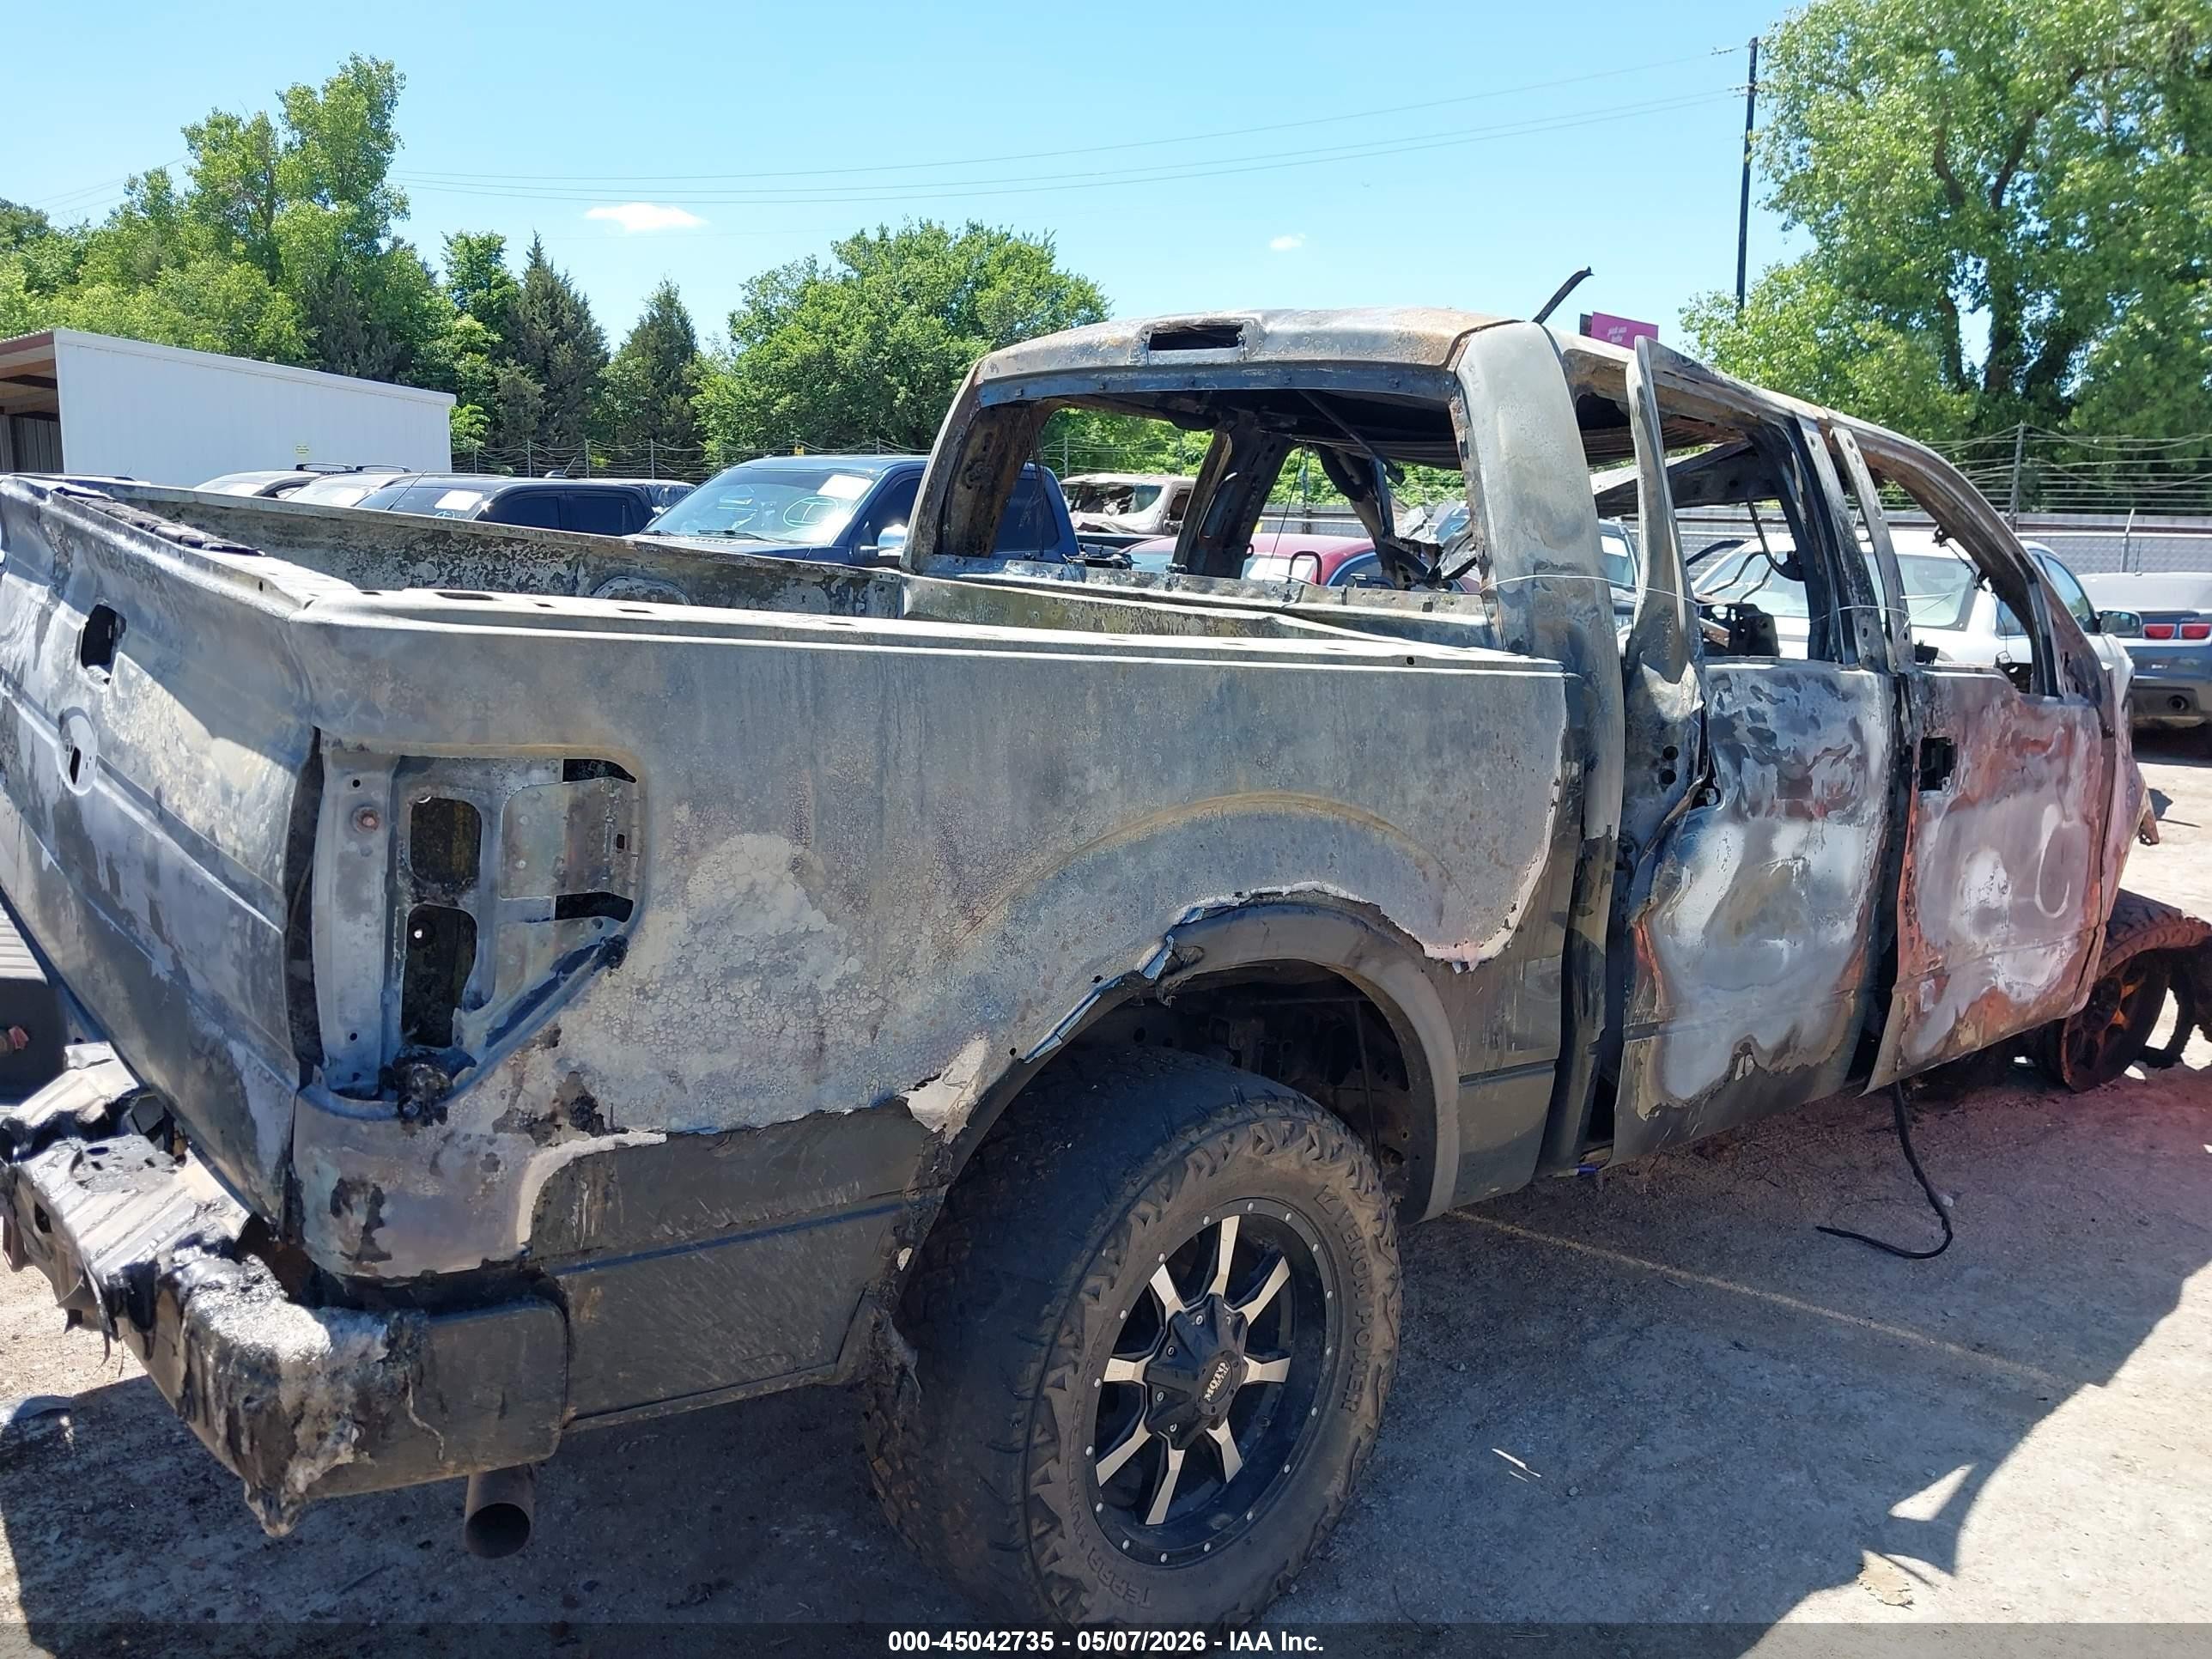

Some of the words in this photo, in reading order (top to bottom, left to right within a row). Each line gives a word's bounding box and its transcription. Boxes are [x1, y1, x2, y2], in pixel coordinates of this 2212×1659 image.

[1204, 1362, 1226, 1402] MOTO
[1340, 1309, 1376, 1415] POWER
[1086, 1547, 1150, 1609] TERRA
